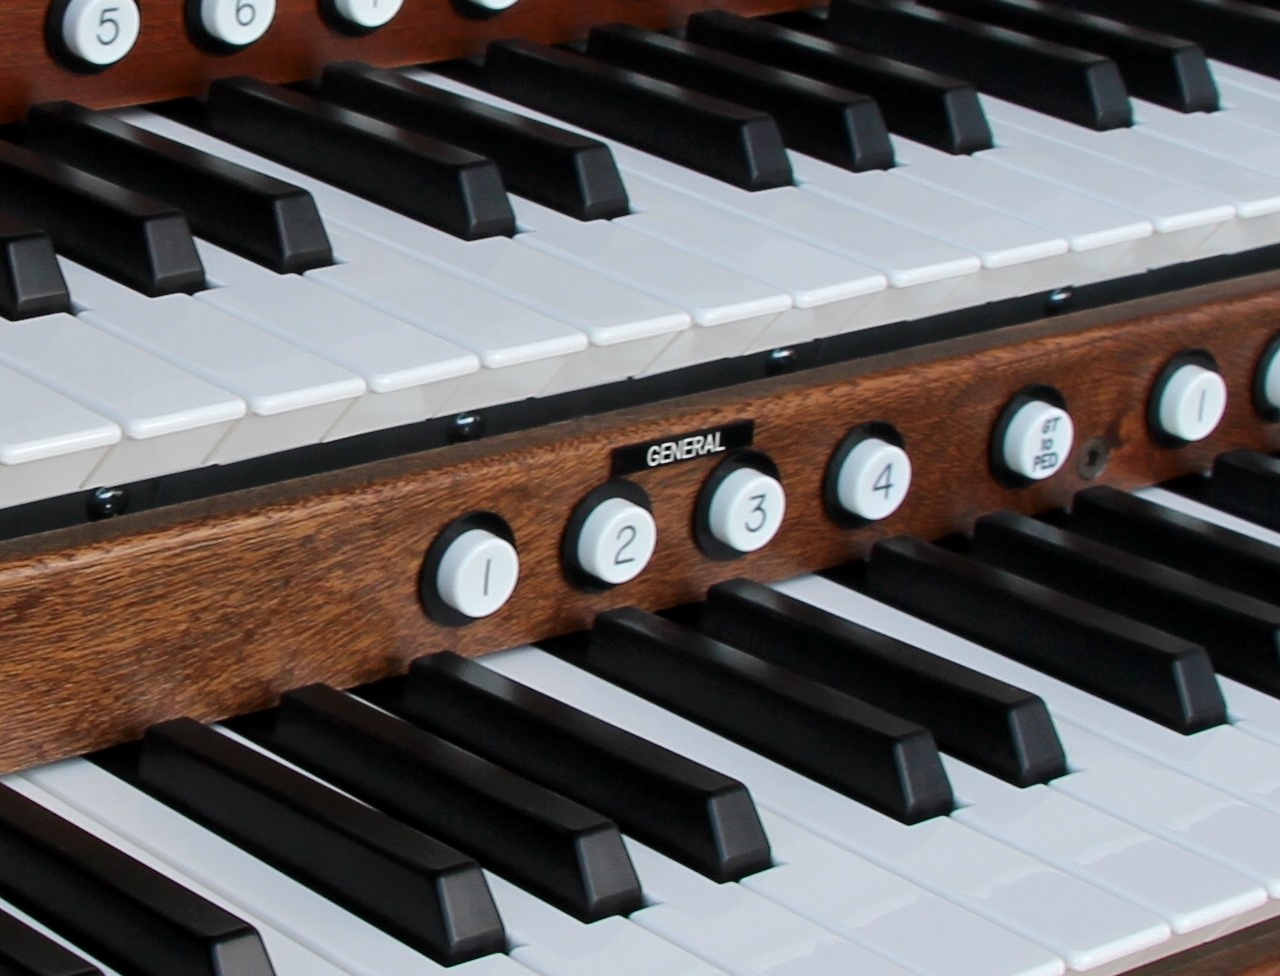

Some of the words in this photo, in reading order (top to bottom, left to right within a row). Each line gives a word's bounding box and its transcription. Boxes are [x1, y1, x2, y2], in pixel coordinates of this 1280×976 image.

[96, 7, 121, 46] 5
[1197, 388, 1208, 423] 1
[647, 431, 726, 467] GENERAL
[1032, 452, 1059, 473] PED
[872, 463, 895, 500] 4
[743, 493, 767, 533] 3
[614, 525, 637, 566] 2
[482, 557, 492, 597] 1
